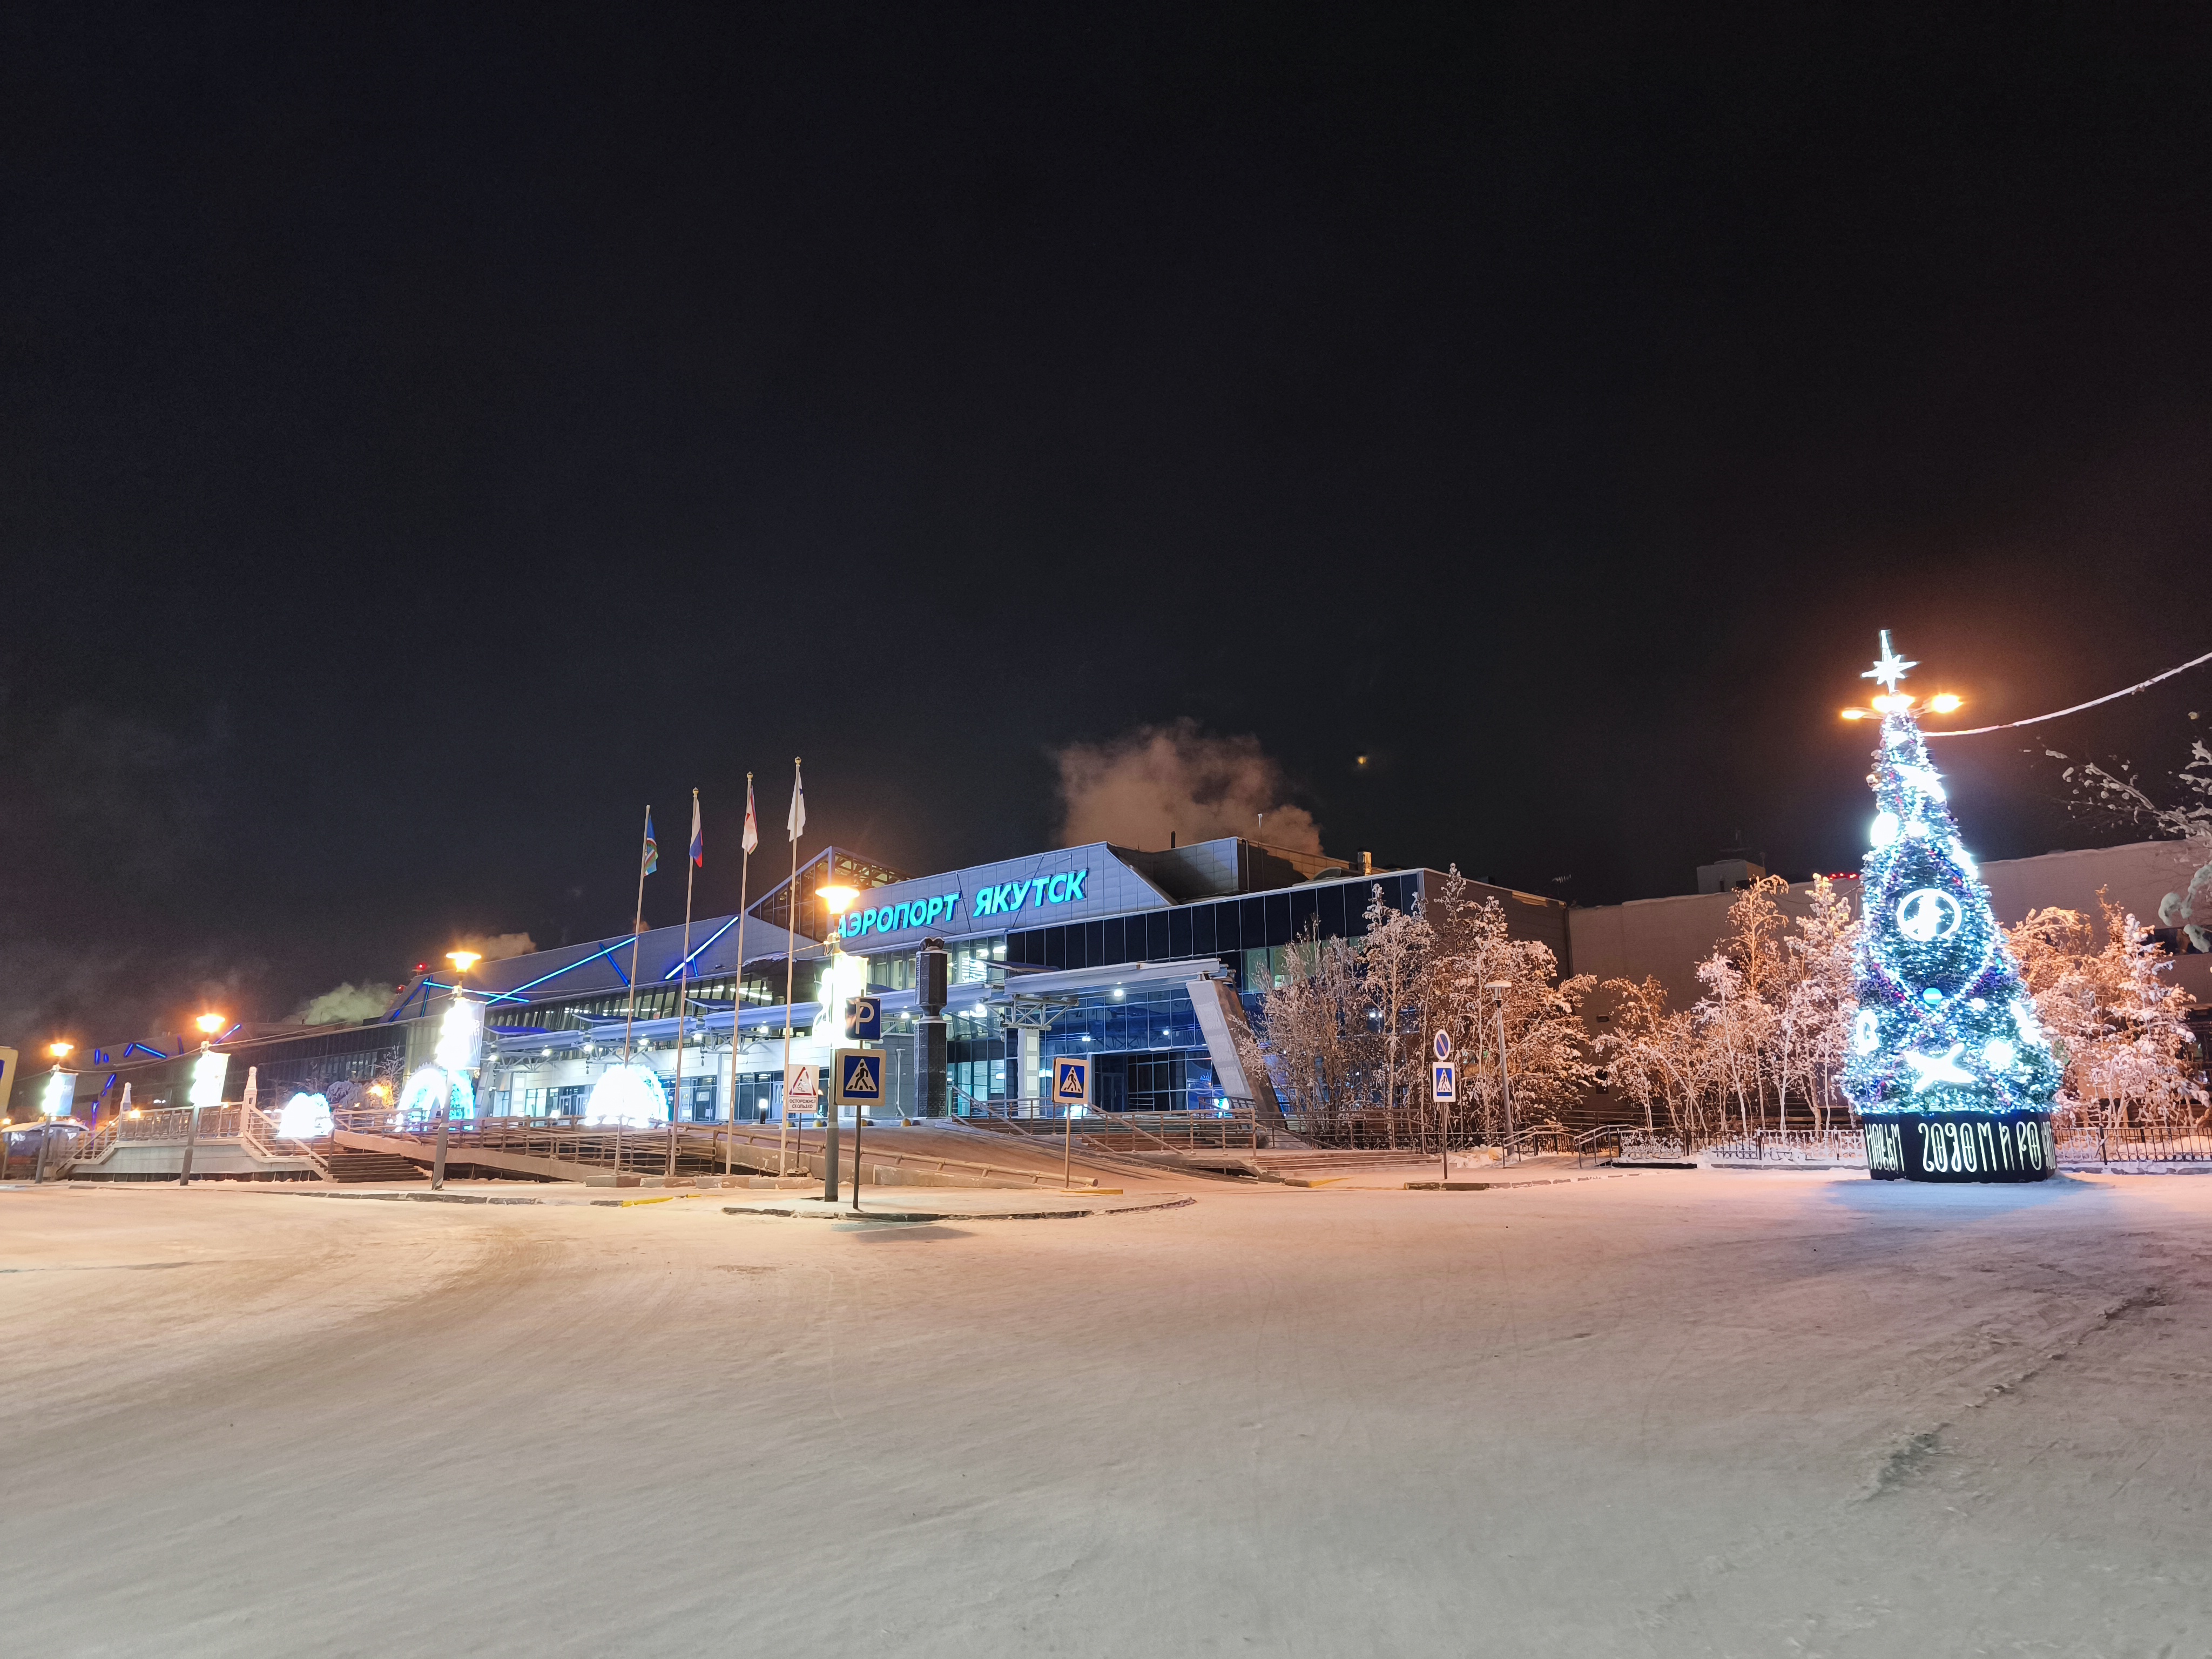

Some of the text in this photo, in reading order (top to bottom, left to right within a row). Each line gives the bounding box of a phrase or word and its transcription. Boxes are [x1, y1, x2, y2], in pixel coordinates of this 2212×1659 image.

[838, 869, 1087, 938] АЭРОПОРТ ЯКУТСК
[855, 1001, 874, 1034] P
